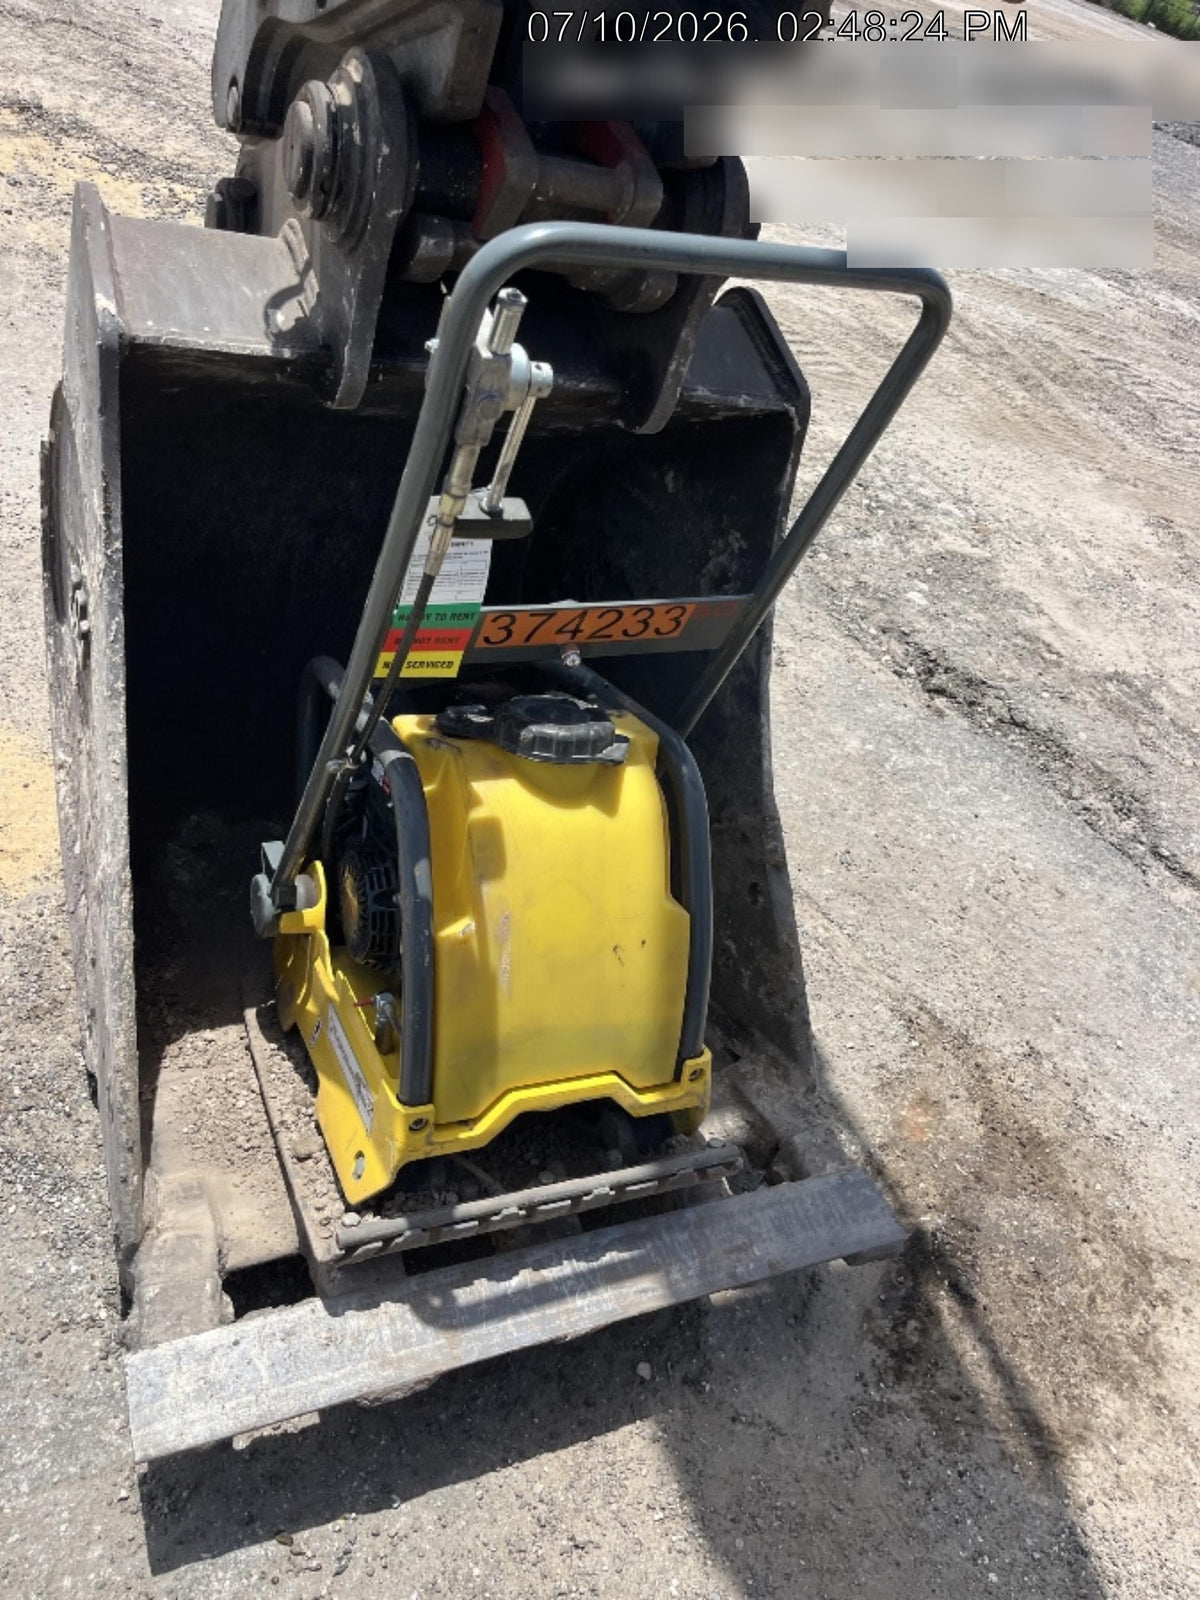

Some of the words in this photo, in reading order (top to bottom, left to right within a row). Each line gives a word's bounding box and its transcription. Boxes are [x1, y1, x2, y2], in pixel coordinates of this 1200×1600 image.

[435, 612, 447, 621] TO
[450, 612, 477, 621] RENT
[483, 605, 687, 645] 374233
[405, 660, 454, 669] SERVICED
